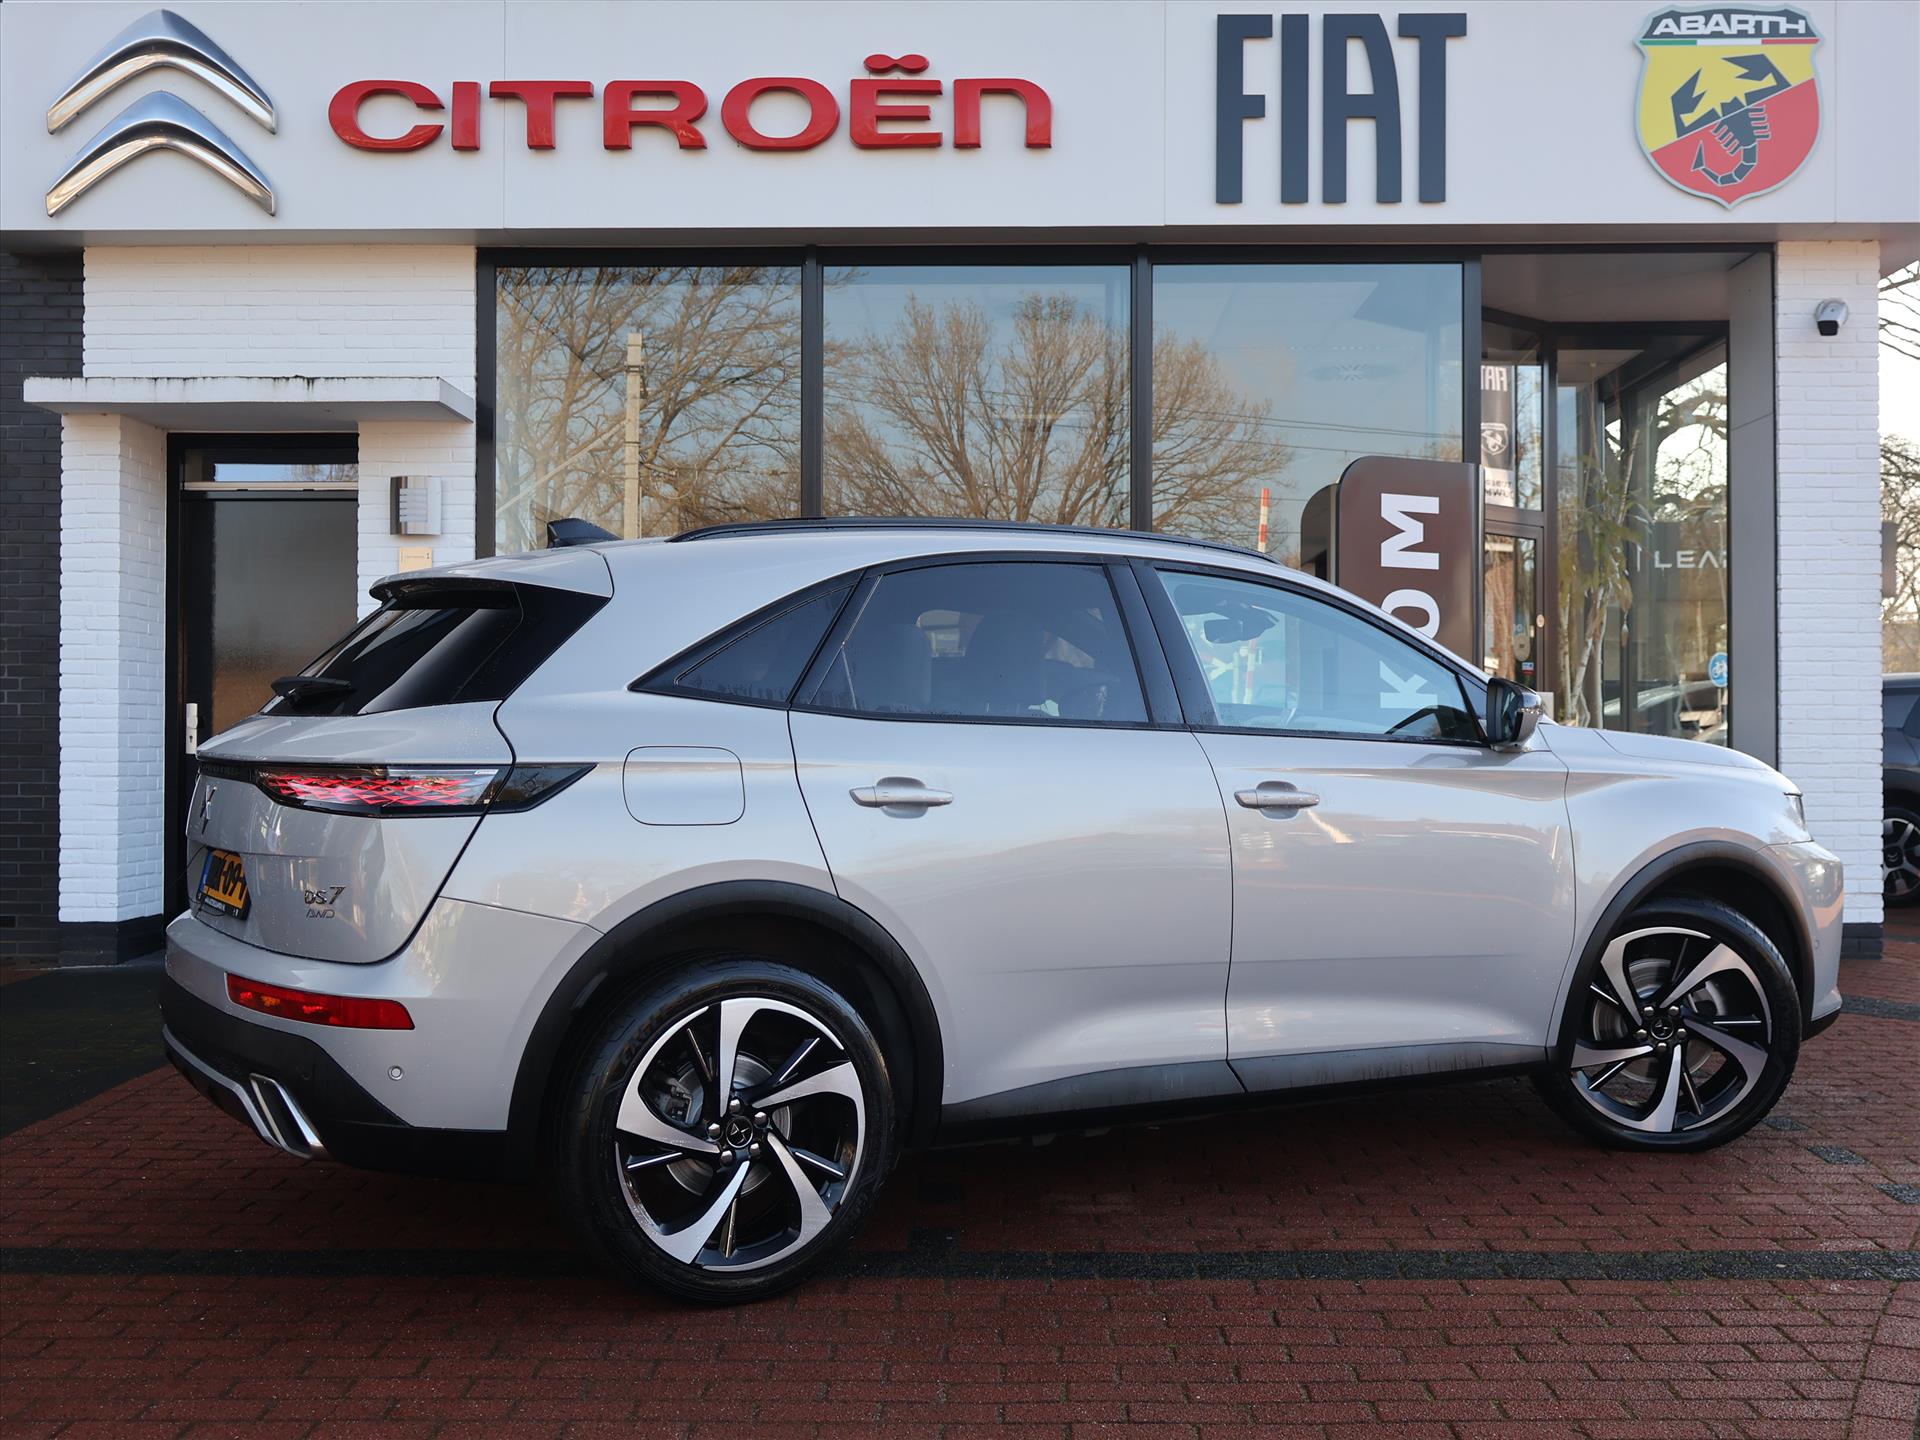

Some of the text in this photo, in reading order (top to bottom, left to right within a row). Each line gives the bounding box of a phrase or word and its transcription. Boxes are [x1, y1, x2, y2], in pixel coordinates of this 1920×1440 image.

[1652, 13, 1806, 36] ABARTH
[328, 53, 1054, 152] CITROËN
[1215, 12, 1468, 205] FIAT
